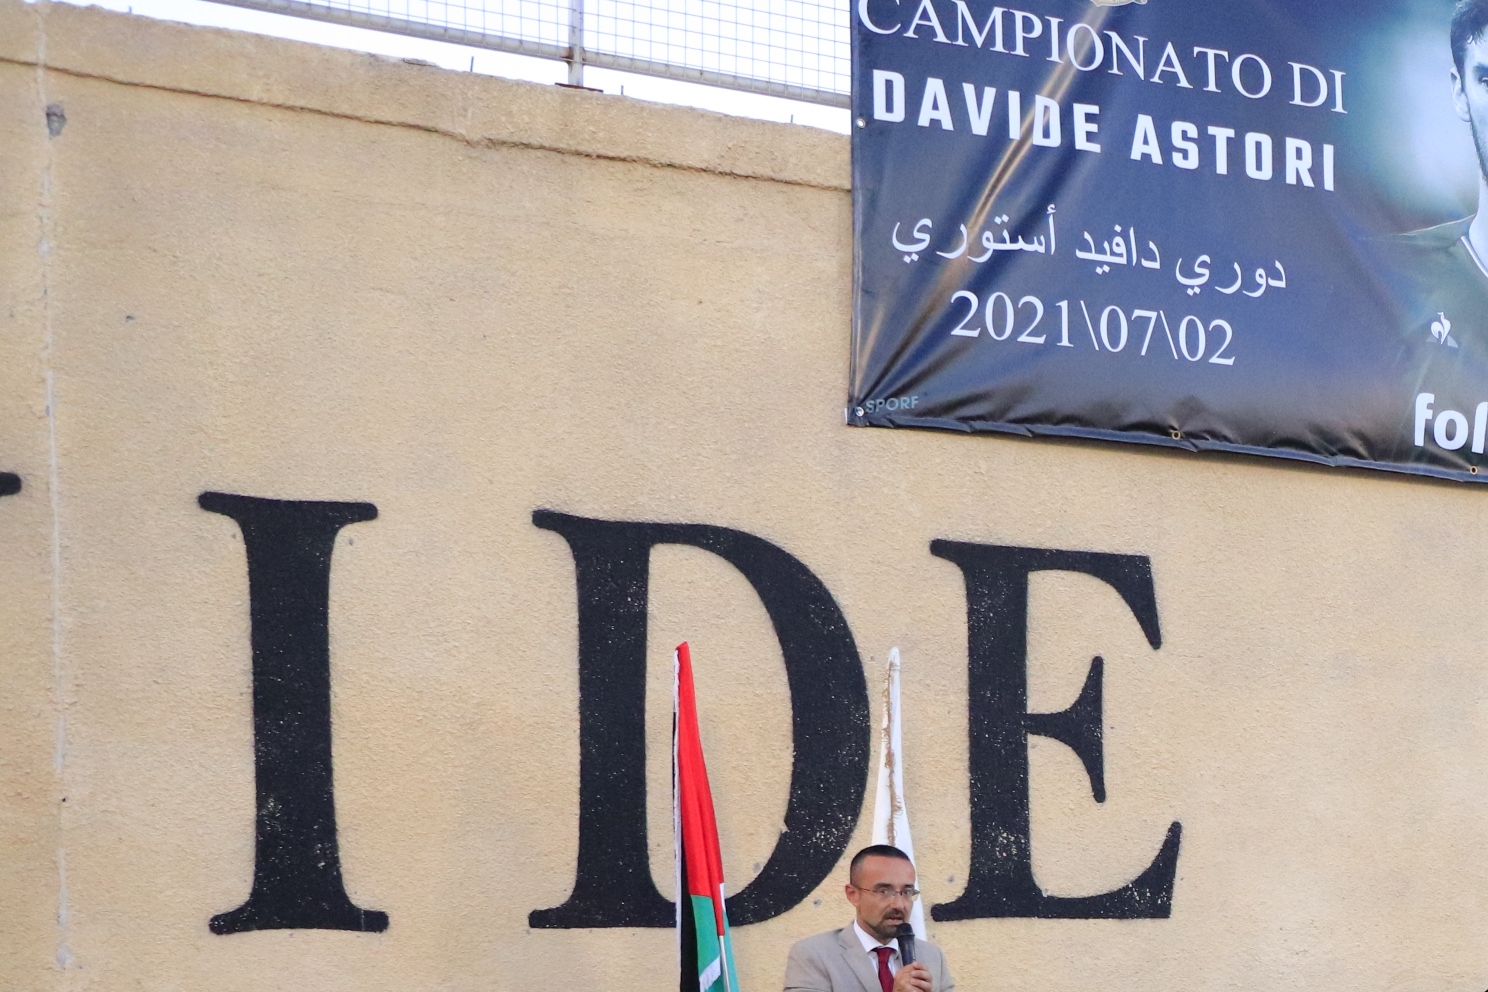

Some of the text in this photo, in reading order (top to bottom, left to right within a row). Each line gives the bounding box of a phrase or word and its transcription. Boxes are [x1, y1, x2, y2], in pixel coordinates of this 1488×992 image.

[858, 0, 1348, 114] CAMPIONATO DI
[872, 69, 1335, 192] DAVIDE ASTORI
[891, 203, 1287, 298] دوري دافيد أستوري
[950, 290, 1236, 366] 2021\07\02
[0, 472, 1182, 936] IDE
